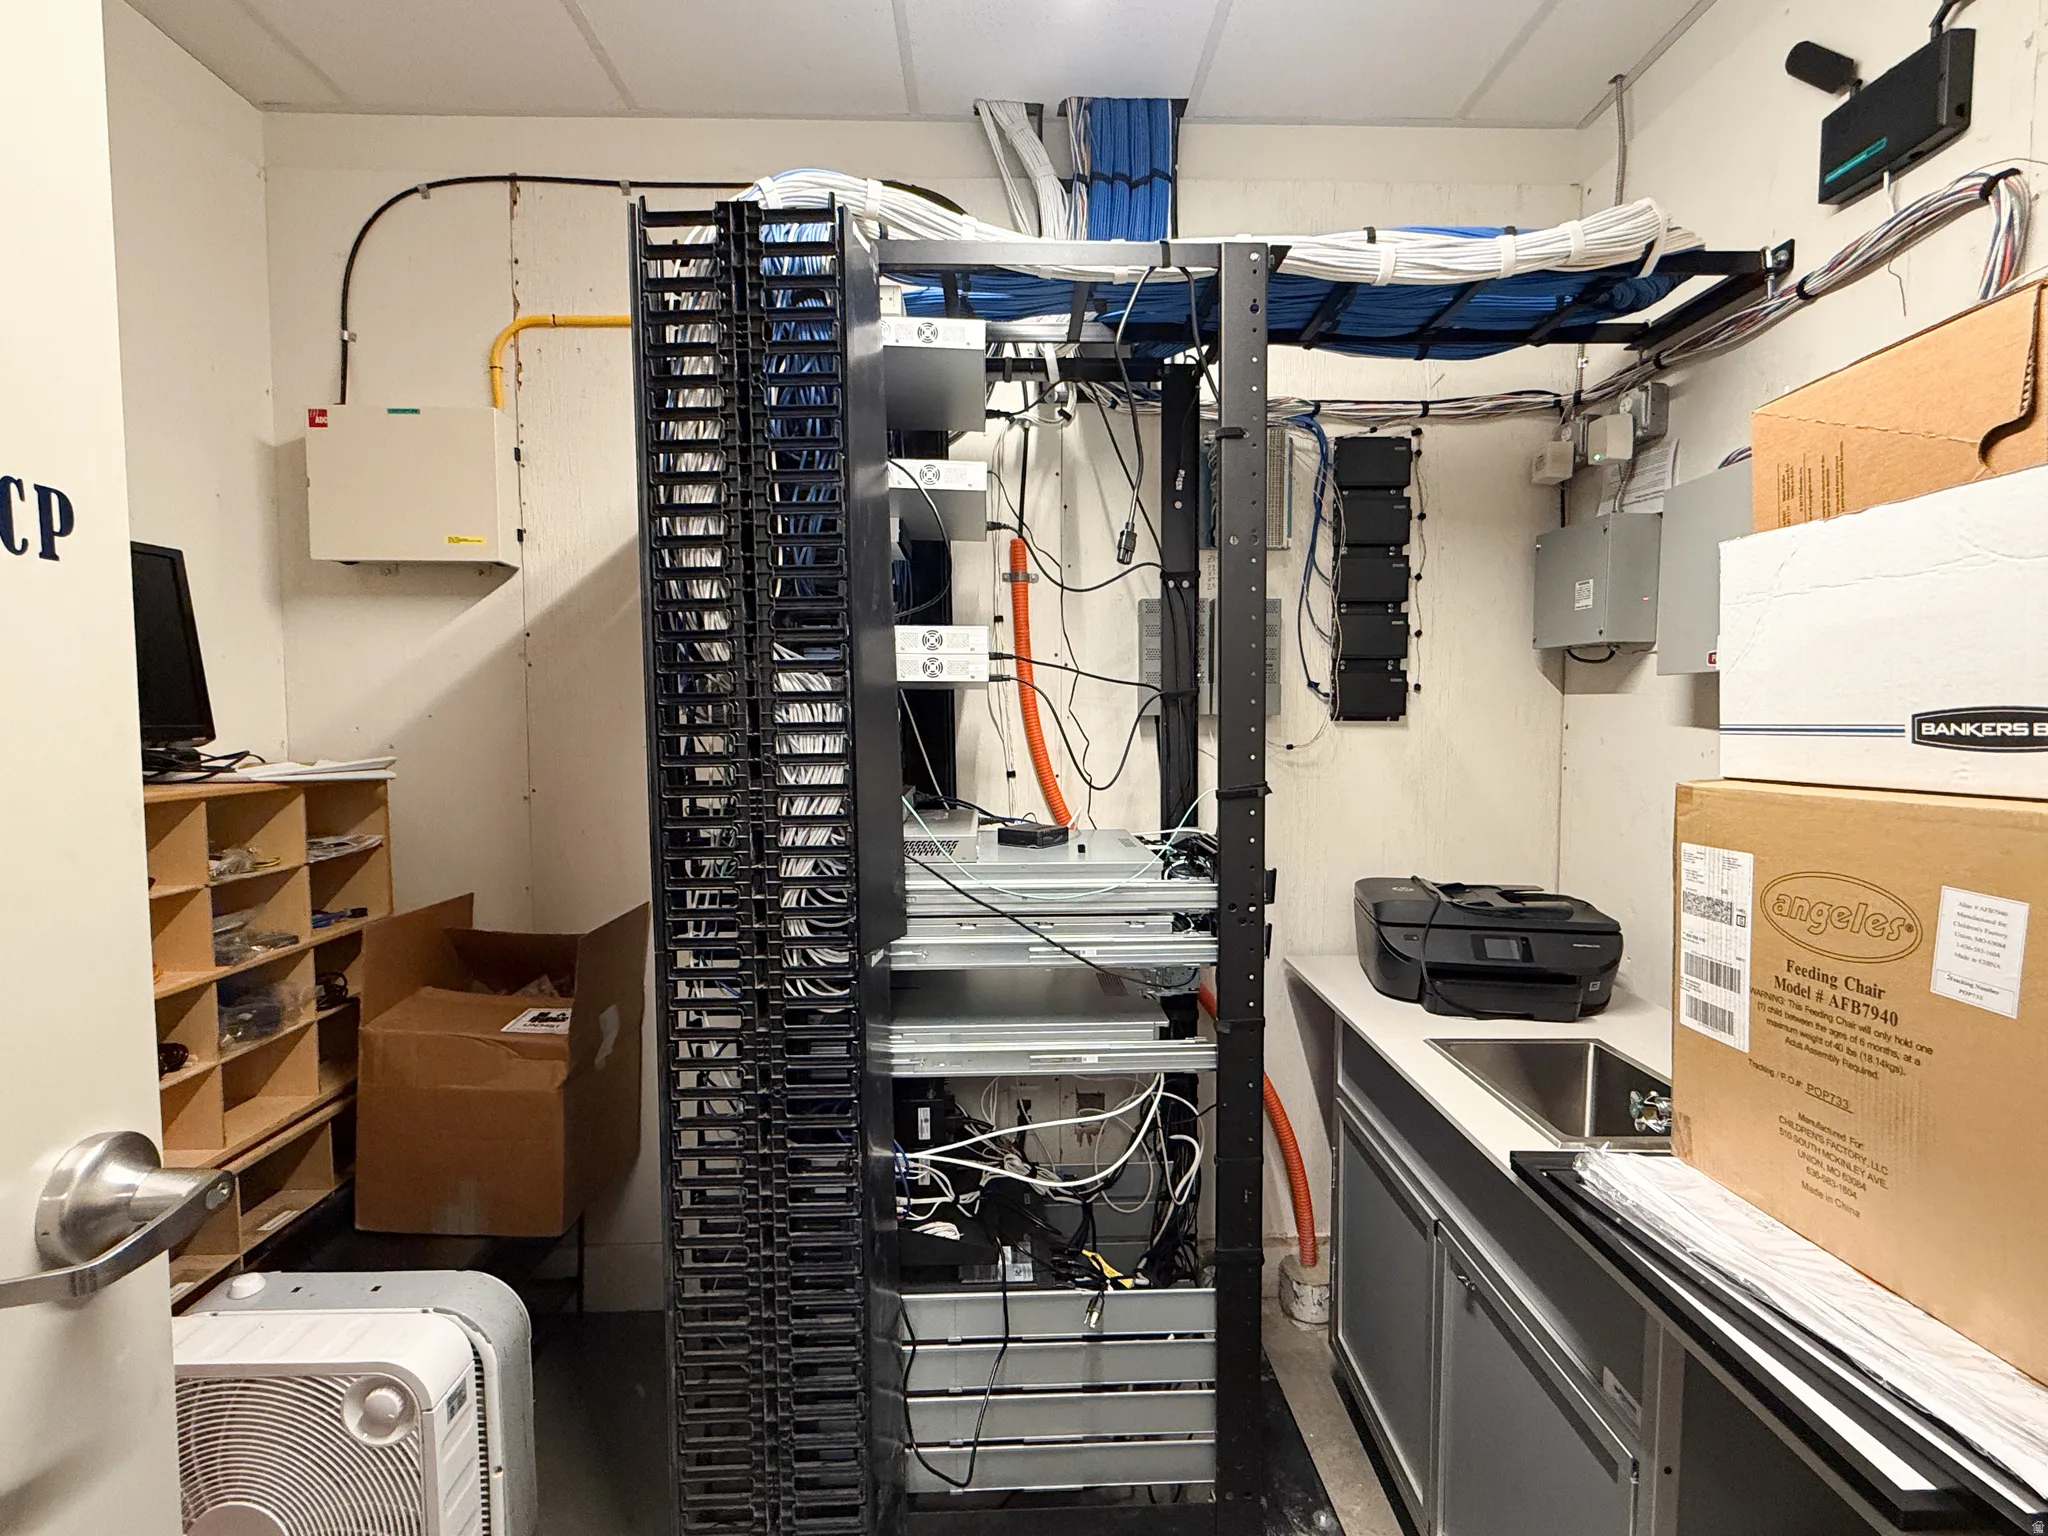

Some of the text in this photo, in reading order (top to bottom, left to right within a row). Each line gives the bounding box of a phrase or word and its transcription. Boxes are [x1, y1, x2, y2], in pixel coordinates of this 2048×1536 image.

[0, 475, 74, 561] CP
[1921, 722, 2029, 737] BANKERS
[1786, 959, 1886, 1000] Feeding Chair
[1774, 975, 1899, 1027] Model # AFB7940
[1766, 1018, 1798, 1035] maximum
[1800, 1030, 1823, 1045] weight
[1825, 1039, 1834, 1049] of
[1833, 1042, 1843, 1052] 40
[1846, 1047, 1857, 1057] lbs
[1767, 1006, 1782, 1017] child
[1784, 1011, 1814, 1027] between
[1815, 1022, 1827, 1033] the
[1829, 1028, 1847, 1042] ages
[1849, 1035, 1858, 1044] of
[1860, 1038, 1865, 1047] 6
[1867, 1041, 1900, 1060] months,
[1903, 1054, 1912, 1063] at
[1914, 1058, 1921, 1066] a
[1788, 999, 1803, 1011] This
[1805, 1005, 1833, 1024] Feeding
[1835, 1016, 1857, 1029] Chair
[1858, 1025, 1871, 1034] will
[1873, 1030, 1892, 1043] only
[1894, 1035, 1913, 1048] hold
[1915, 1043, 1933, 1055] one
[1785, 1036, 1803, 1051] Adult
[1804, 1044, 1840, 1066] Assembly
[1748, 1059, 1775, 1078] Tracking
[1806, 1083, 1850, 1110] POP733
[1798, 1112, 1847, 1142] Manufactured
[1779, 1127, 1792, 1140] 510
[1794, 1133, 1821, 1155] SOUTH
[1822, 1149, 1866, 1178] MCKINLEY
[1871, 1160, 1889, 1176] LLC
[1826, 1164, 1841, 1177] MO
[1841, 1171, 1867, 1192] 63084
[1801, 1180, 1860, 1218] Made in China
